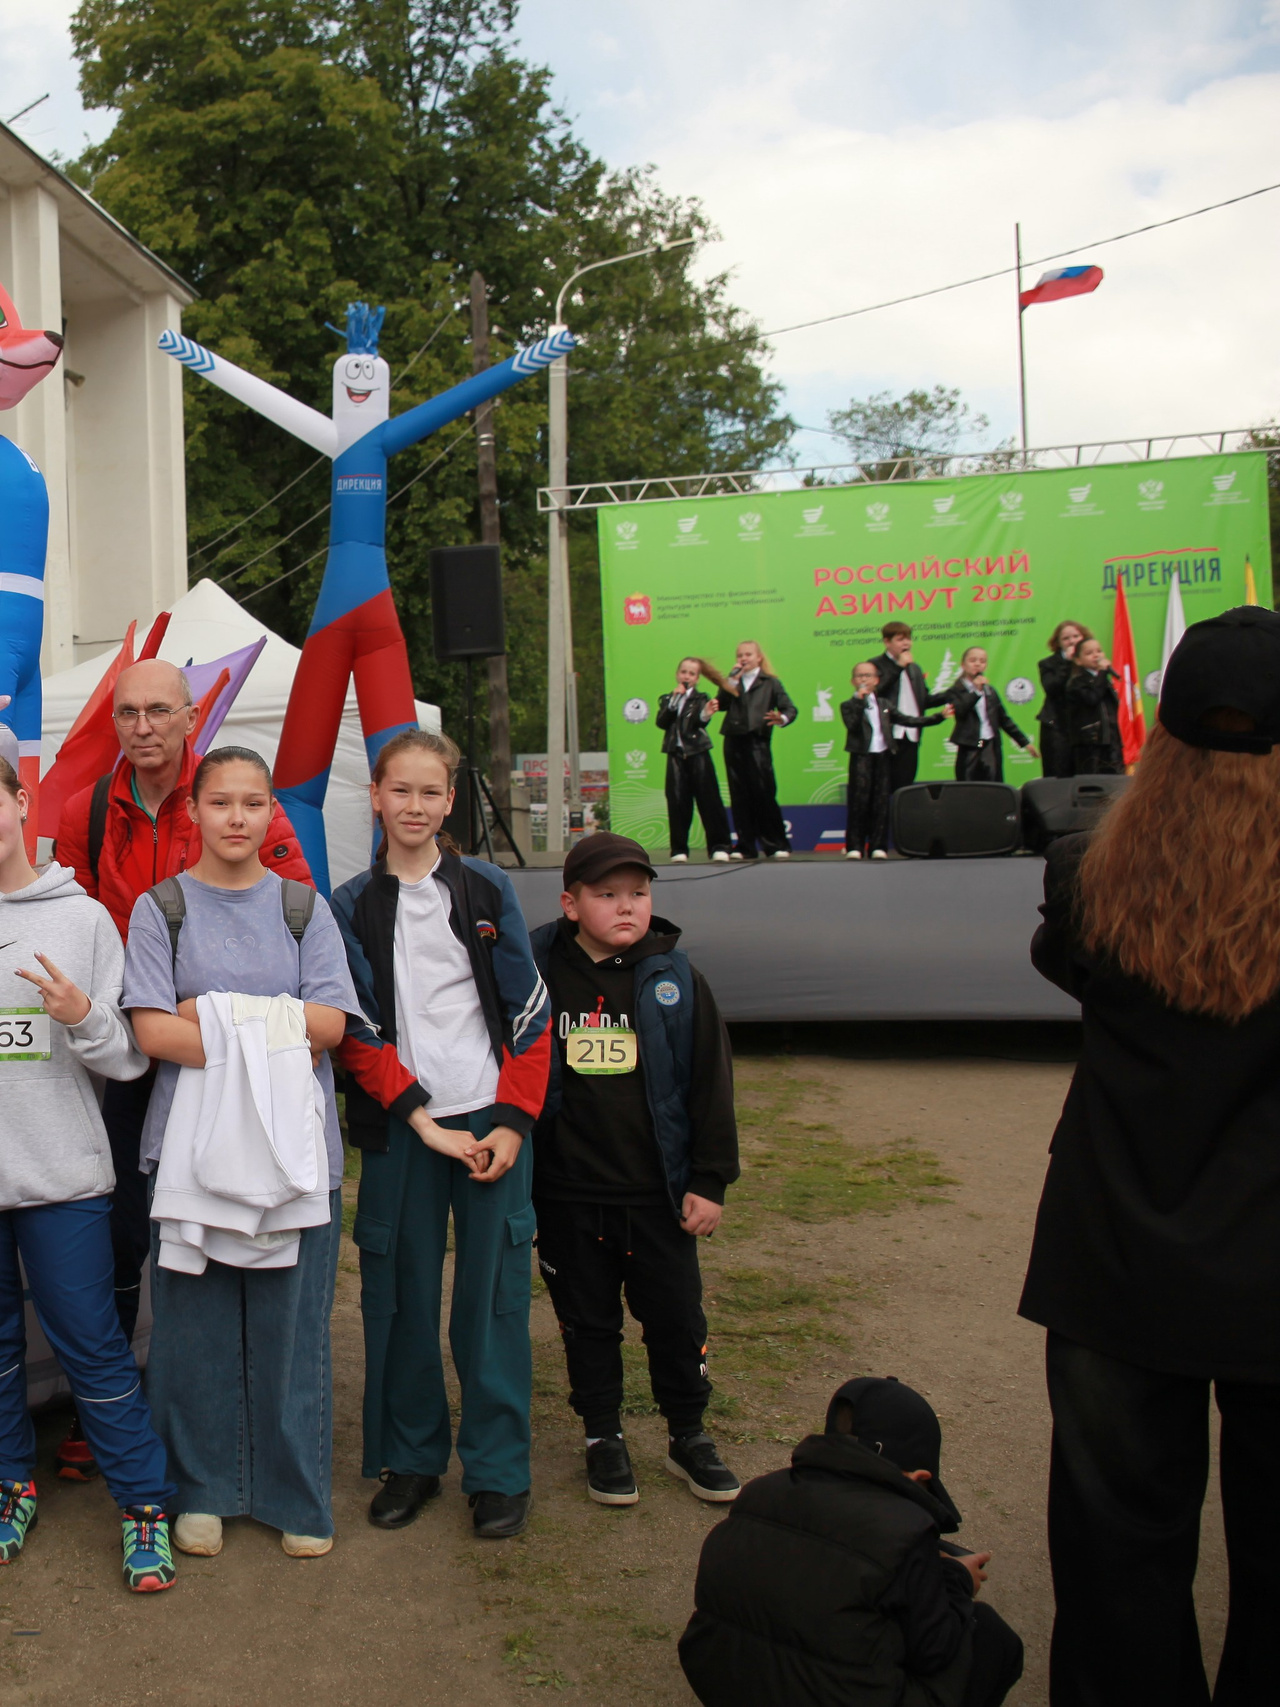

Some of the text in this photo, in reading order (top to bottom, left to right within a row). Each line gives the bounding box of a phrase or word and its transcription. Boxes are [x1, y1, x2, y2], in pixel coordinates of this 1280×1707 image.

[336, 478, 382, 491] ДИРЕКЦИЯ
[814, 548, 1030, 588] РОССИЙСКИЙ
[1102, 557, 1222, 591] ДИРЕКЦИЯ
[815, 581, 1033, 618] АЗИМУТ 2025
[577, 1039, 627, 1063] 215
